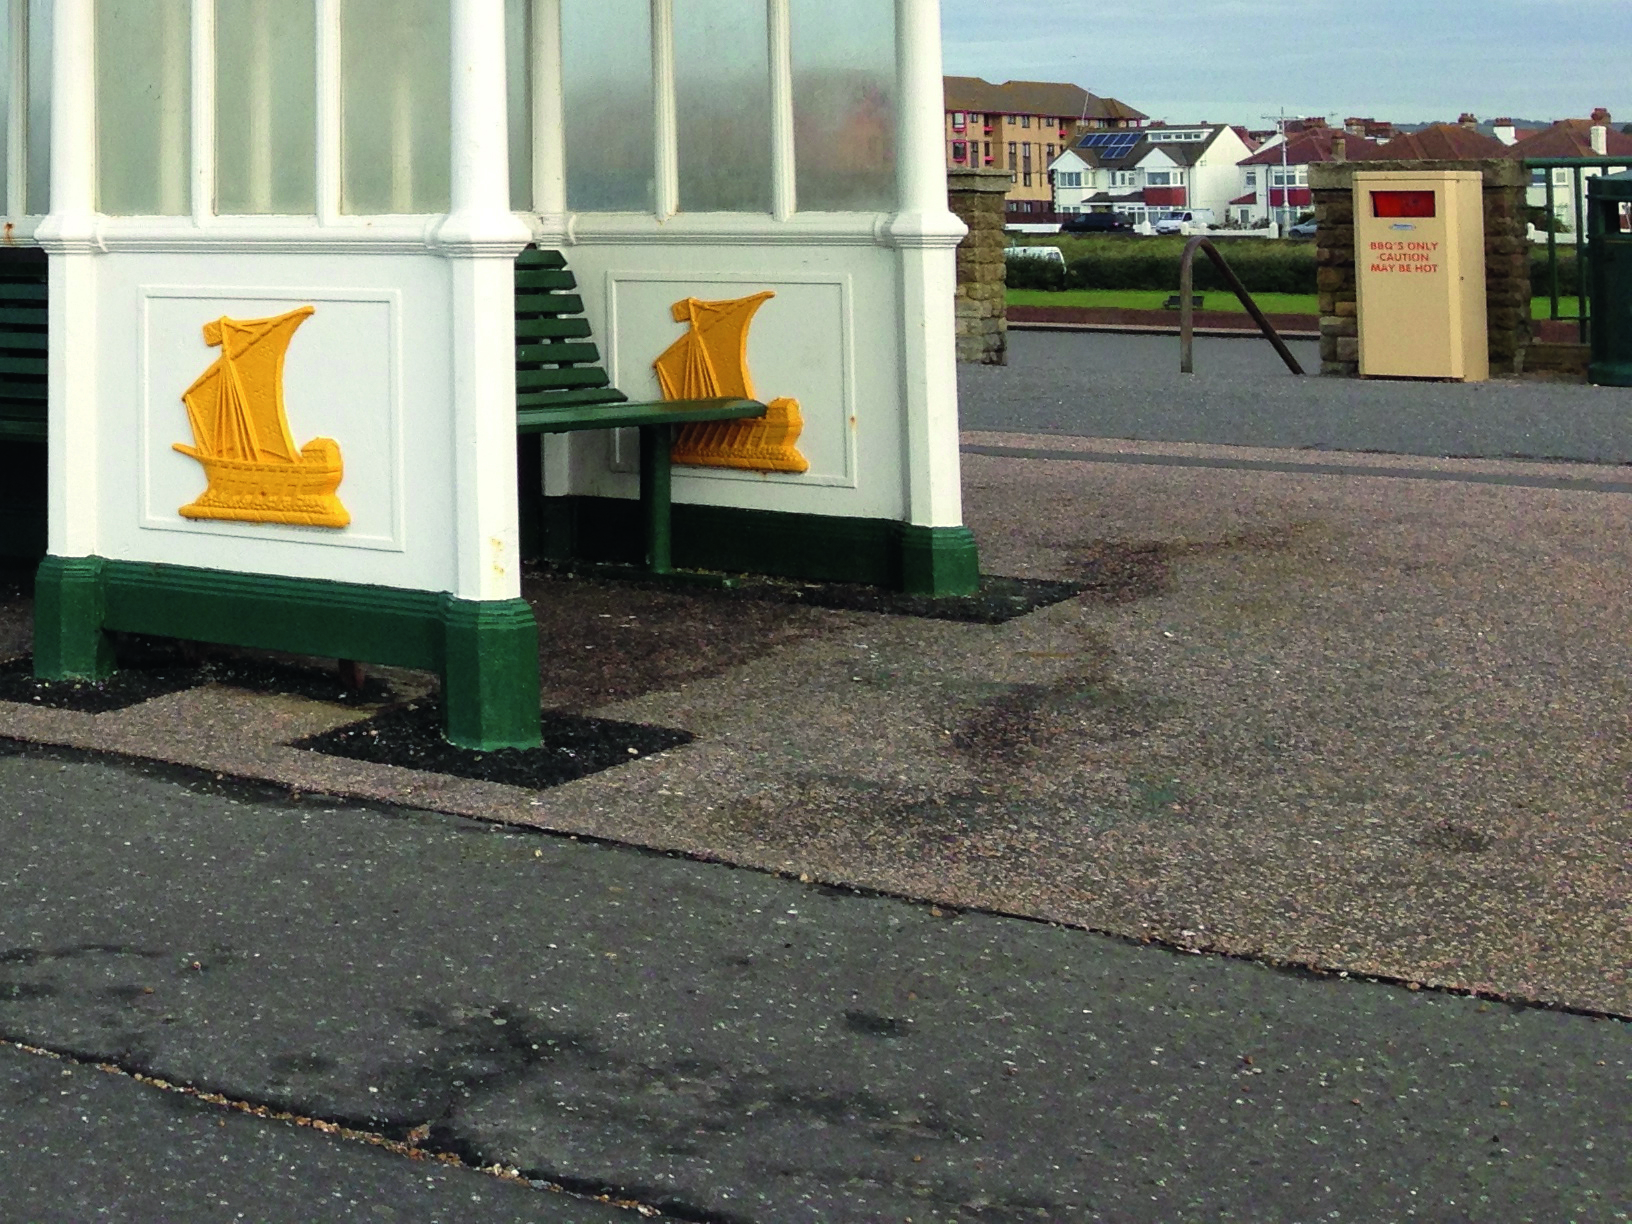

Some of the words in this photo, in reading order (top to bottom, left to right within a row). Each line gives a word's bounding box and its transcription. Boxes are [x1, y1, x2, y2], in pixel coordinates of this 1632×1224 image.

[1407, 241, 1439, 251] ONLY
[1379, 253, 1429, 262] CAUTION
[1370, 263, 1395, 273] MAY
[1398, 263, 1412, 273] BE
[1415, 263, 1438, 273] HOT
